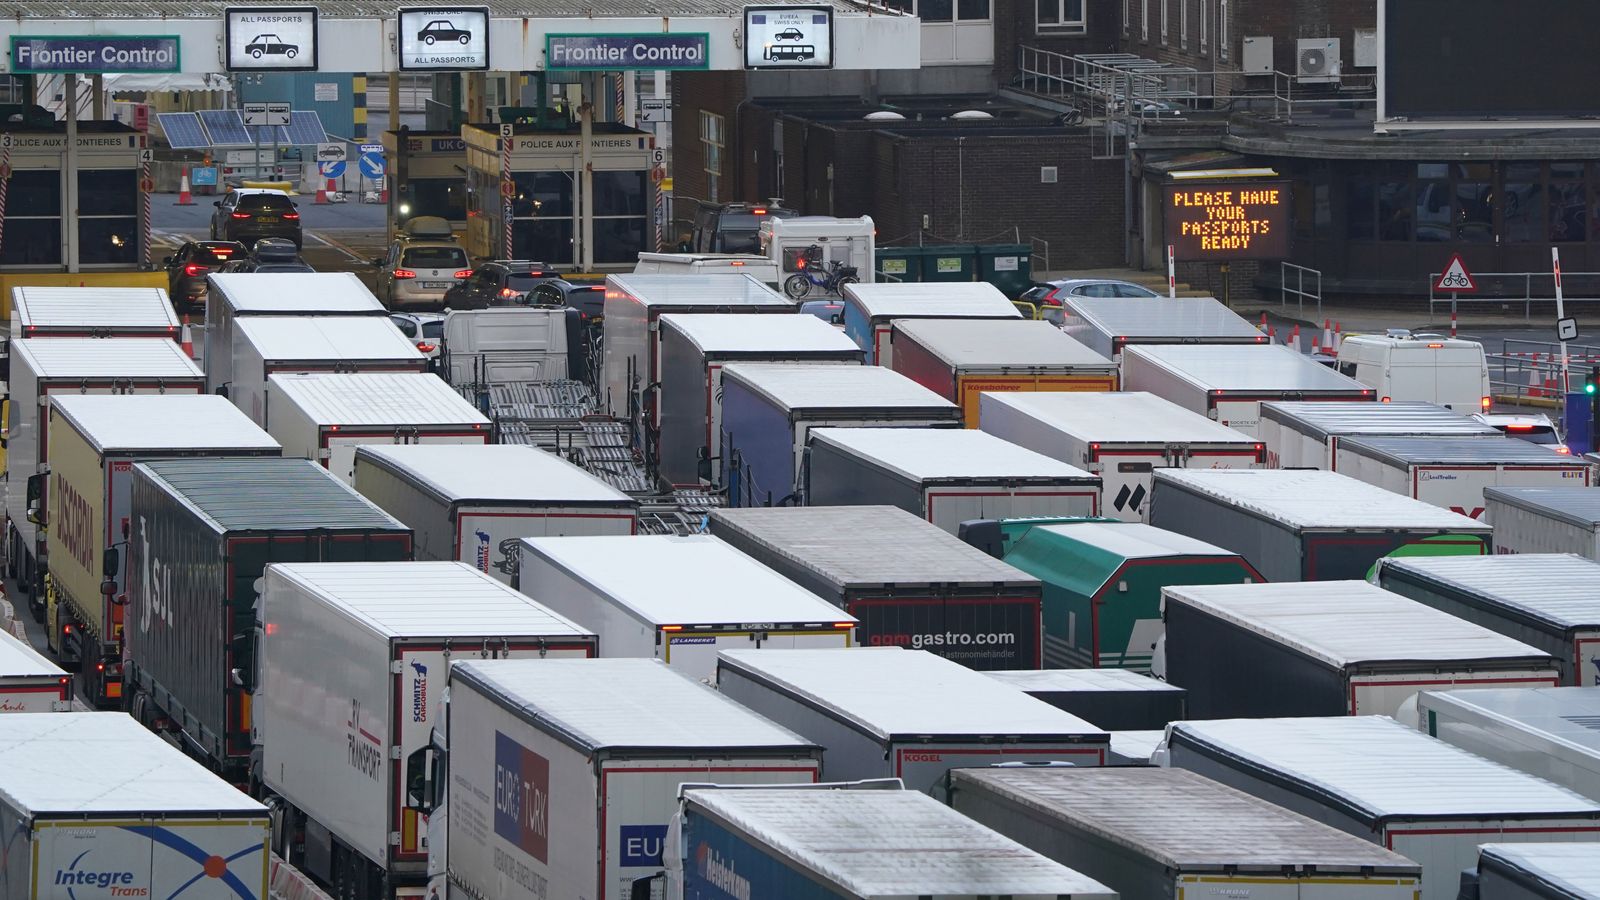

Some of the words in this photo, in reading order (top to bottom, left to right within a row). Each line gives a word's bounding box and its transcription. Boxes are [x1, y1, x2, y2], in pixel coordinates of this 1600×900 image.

[257, 15, 303, 23] PASSPORTS
[18, 47, 94, 64] Frontier
[101, 44, 173, 63] Control
[553, 44, 627, 61] Frontier
[633, 42, 702, 60] Control
[503, 125, 510, 135] 5
[3, 136, 11, 147] 3
[13, 138, 40, 146] OLICE
[43, 138, 60, 146] AUX
[64, 138, 122, 146] FONTIERES
[439, 140, 456, 149] UK
[457, 140, 467, 149] C
[521, 140, 553, 148] POLICE
[556, 140, 574, 148] AUX
[576, 139, 632, 148] FONTIERES
[142, 151, 151, 161] 4
[655, 151, 663, 161] 6
[1174, 192, 1232, 206] PLEASE
[1240, 191, 1279, 204] HAVE
[1206, 206, 1245, 219] YOUR
[1182, 220, 1269, 235] PASSPORTS
[1202, 235, 1250, 249] READY
[57, 472, 94, 577] DISCORDIA
[347, 733, 381, 783] TRANSPORT
[497, 764, 519, 823] EURO
[524, 781, 546, 838] TÜRK
[627, 838, 666, 857] EU
[55, 869, 133, 888] Integre
[111, 886, 147, 896] Trans
